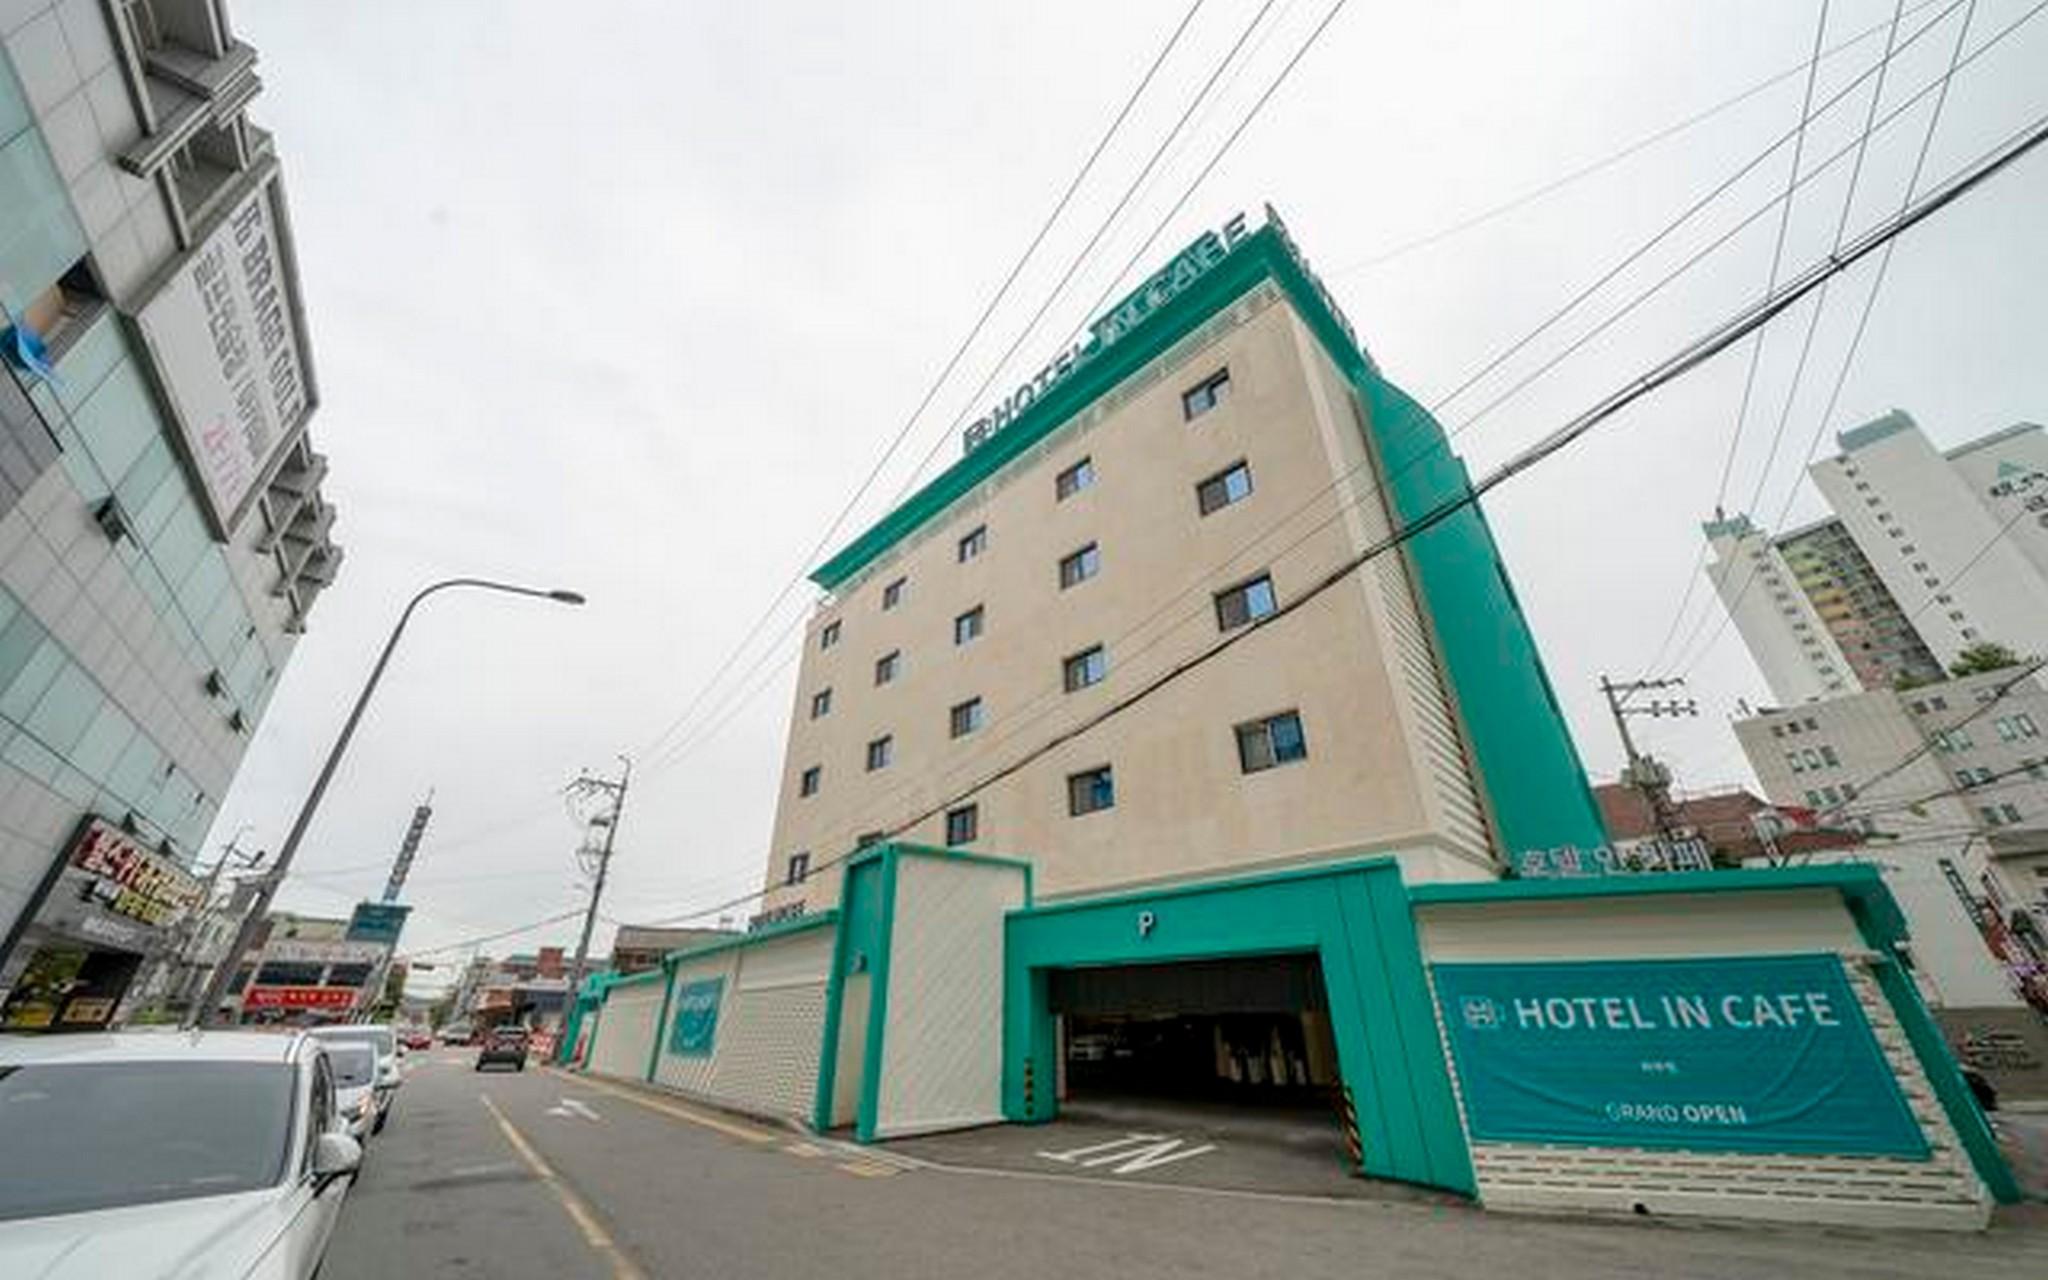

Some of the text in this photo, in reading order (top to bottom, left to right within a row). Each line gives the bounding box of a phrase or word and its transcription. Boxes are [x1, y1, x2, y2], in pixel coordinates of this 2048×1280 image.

[991, 341, 1095, 431] HOTEL
[1138, 910, 1157, 937] P
[1514, 992, 1840, 1030] HOTEL IN CAFE
[1606, 1103, 1749, 1126] GRAND OPEN
[1036, 1132, 1217, 1174] IN
